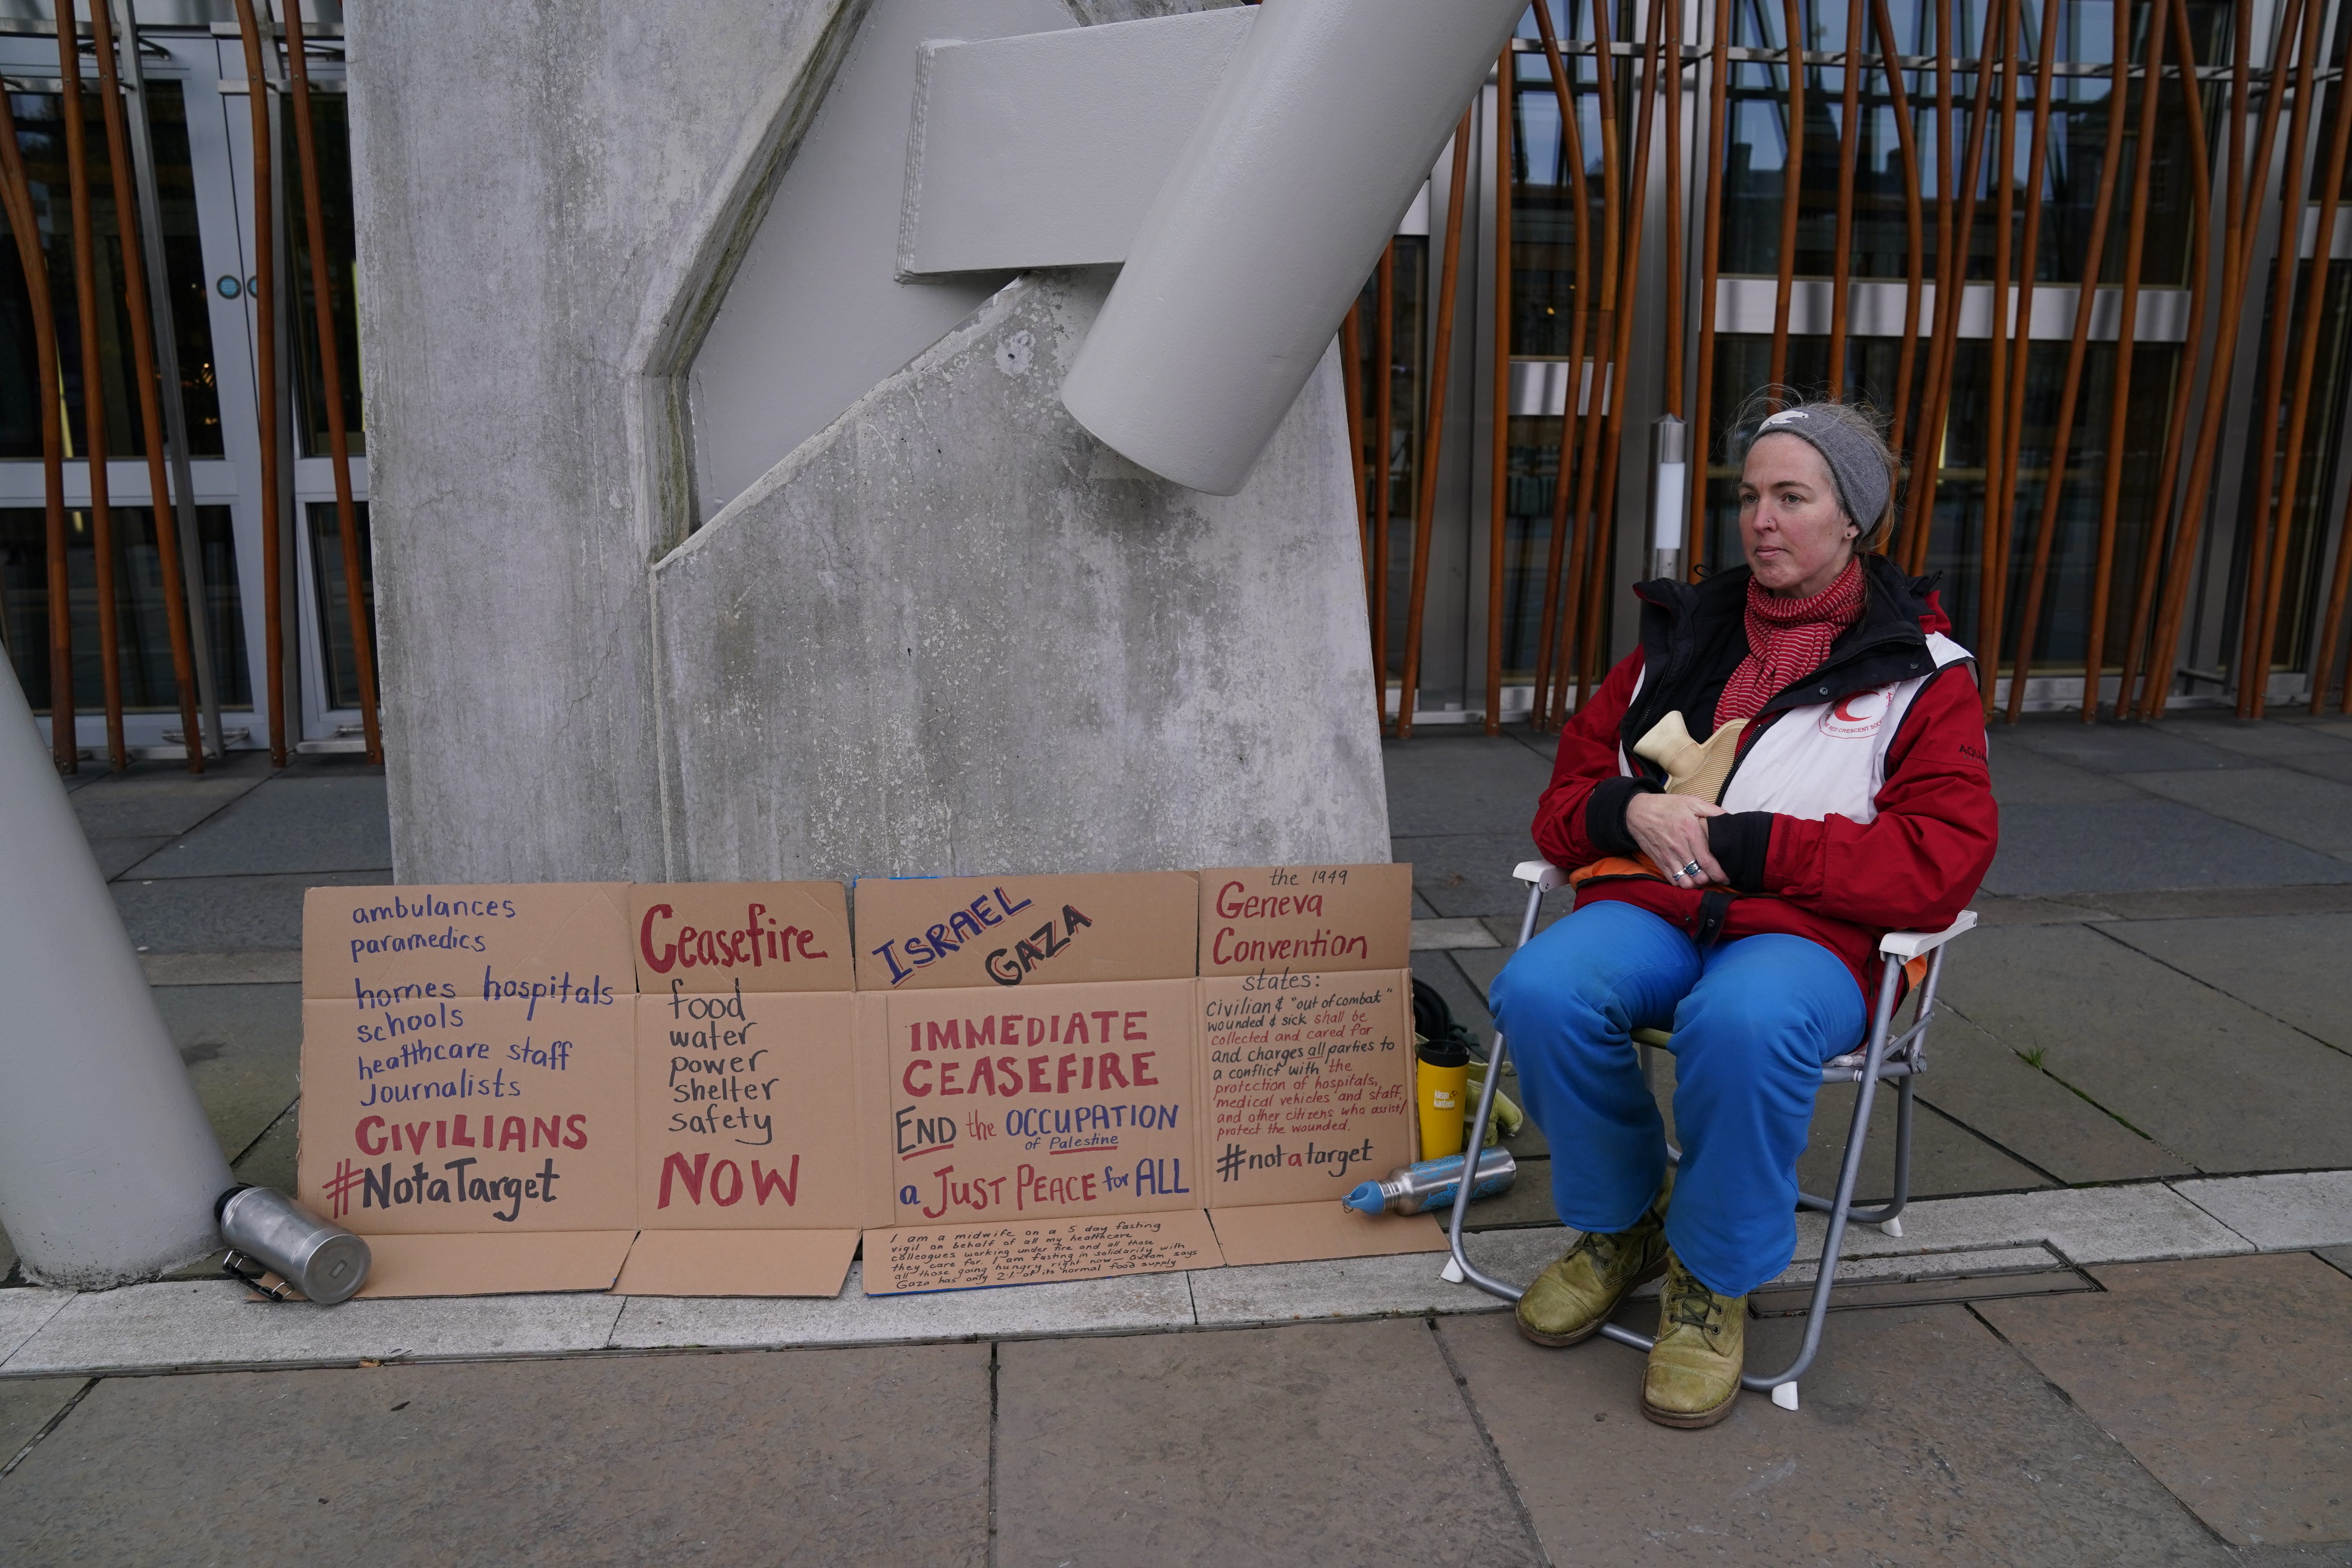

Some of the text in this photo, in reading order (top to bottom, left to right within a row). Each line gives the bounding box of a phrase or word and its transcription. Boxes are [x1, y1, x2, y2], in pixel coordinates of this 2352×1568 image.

[1269, 868, 1347, 885] the 1949
[353, 894, 515, 924] ambulances
[1216, 881, 1322, 918] Geneva
[351, 926, 486, 963] paramedics
[641, 904, 828, 974] Ceasefire
[871, 887, 1033, 985] ISRAEL
[985, 904, 1093, 986] GAZA
[1213, 927, 1367, 965] Convention
[354, 965, 613, 1021] homes hospitals
[1243, 967, 1320, 991] states:
[668, 978, 746, 1021] food
[1275, 996, 1284, 1012] &
[1321, 994, 1336, 1008] of
[357, 1003, 463, 1043] schools
[905, 1011, 1147, 1052] IMMEDIATE
[1208, 1009, 1368, 1032] wounded & sick shall be
[1212, 1023, 1373, 1045] collected and cared for
[670, 1021, 757, 1051] water
[358, 1036, 573, 1080] healthcare staff
[1212, 1036, 1394, 1069] and charges all parties to
[669, 1049, 768, 1087] power
[903, 1051, 1159, 1097] CEASEFIRE
[1213, 1058, 1352, 1080] a conflict with the
[673, 1076, 779, 1103] shelter
[1214, 1073, 1377, 1100] protection of hospitals,
[1216, 1084, 1403, 1108] medical vehicles and staff,
[1435, 1090, 1449, 1099] klean
[1217, 1109, 1241, 1124] and
[1249, 1109, 1280, 1122] other
[1286, 1107, 1333, 1120] citizens
[1341, 1103, 1365, 1115] who
[1434, 1098, 1455, 1108] kanteen
[355, 1114, 587, 1156] CIVILIANS
[668, 1103, 772, 1145] safety
[896, 1104, 1179, 1154] END the OCCUPATION
[1217, 1119, 1350, 1141] protect the wounded.
[1025, 1133, 1119, 1150] of Palestine
[322, 1157, 560, 1222] #NotaTarget
[657, 1152, 799, 1209] NOW
[900, 1185, 921, 1205] a
[1017, 1164, 1097, 1210] PEACE
[1102, 1166, 1129, 1192] for
[1136, 1158, 1189, 1197] ALL
[890, 1234, 898, 1243] I
[955, 1229, 1014, 1240] midwife
[1085, 1225, 1107, 1233] day
[1116, 1221, 1161, 1232] fasting
[892, 1245, 919, 1257] vigil
[953, 1240, 995, 1249] behalf
[1070, 1232, 1132, 1241] healthcare
[891, 1252, 955, 1264] colleagues
[964, 1249, 1009, 1258] working
[892, 1263, 920, 1274] they
[1032, 1252, 1073, 1263] fasting
[1094, 1246, 1153, 1258] solidarity
[958, 1267, 987, 1279] going
[995, 1263, 1042, 1275] hungry
[1051, 1259, 1082, 1269] right
[897, 1280, 929, 1289] Gaza
[966, 1273, 987, 1285] only
[1062, 1264, 1101, 1273] normal
[1141, 1259, 1176, 1267] supply
